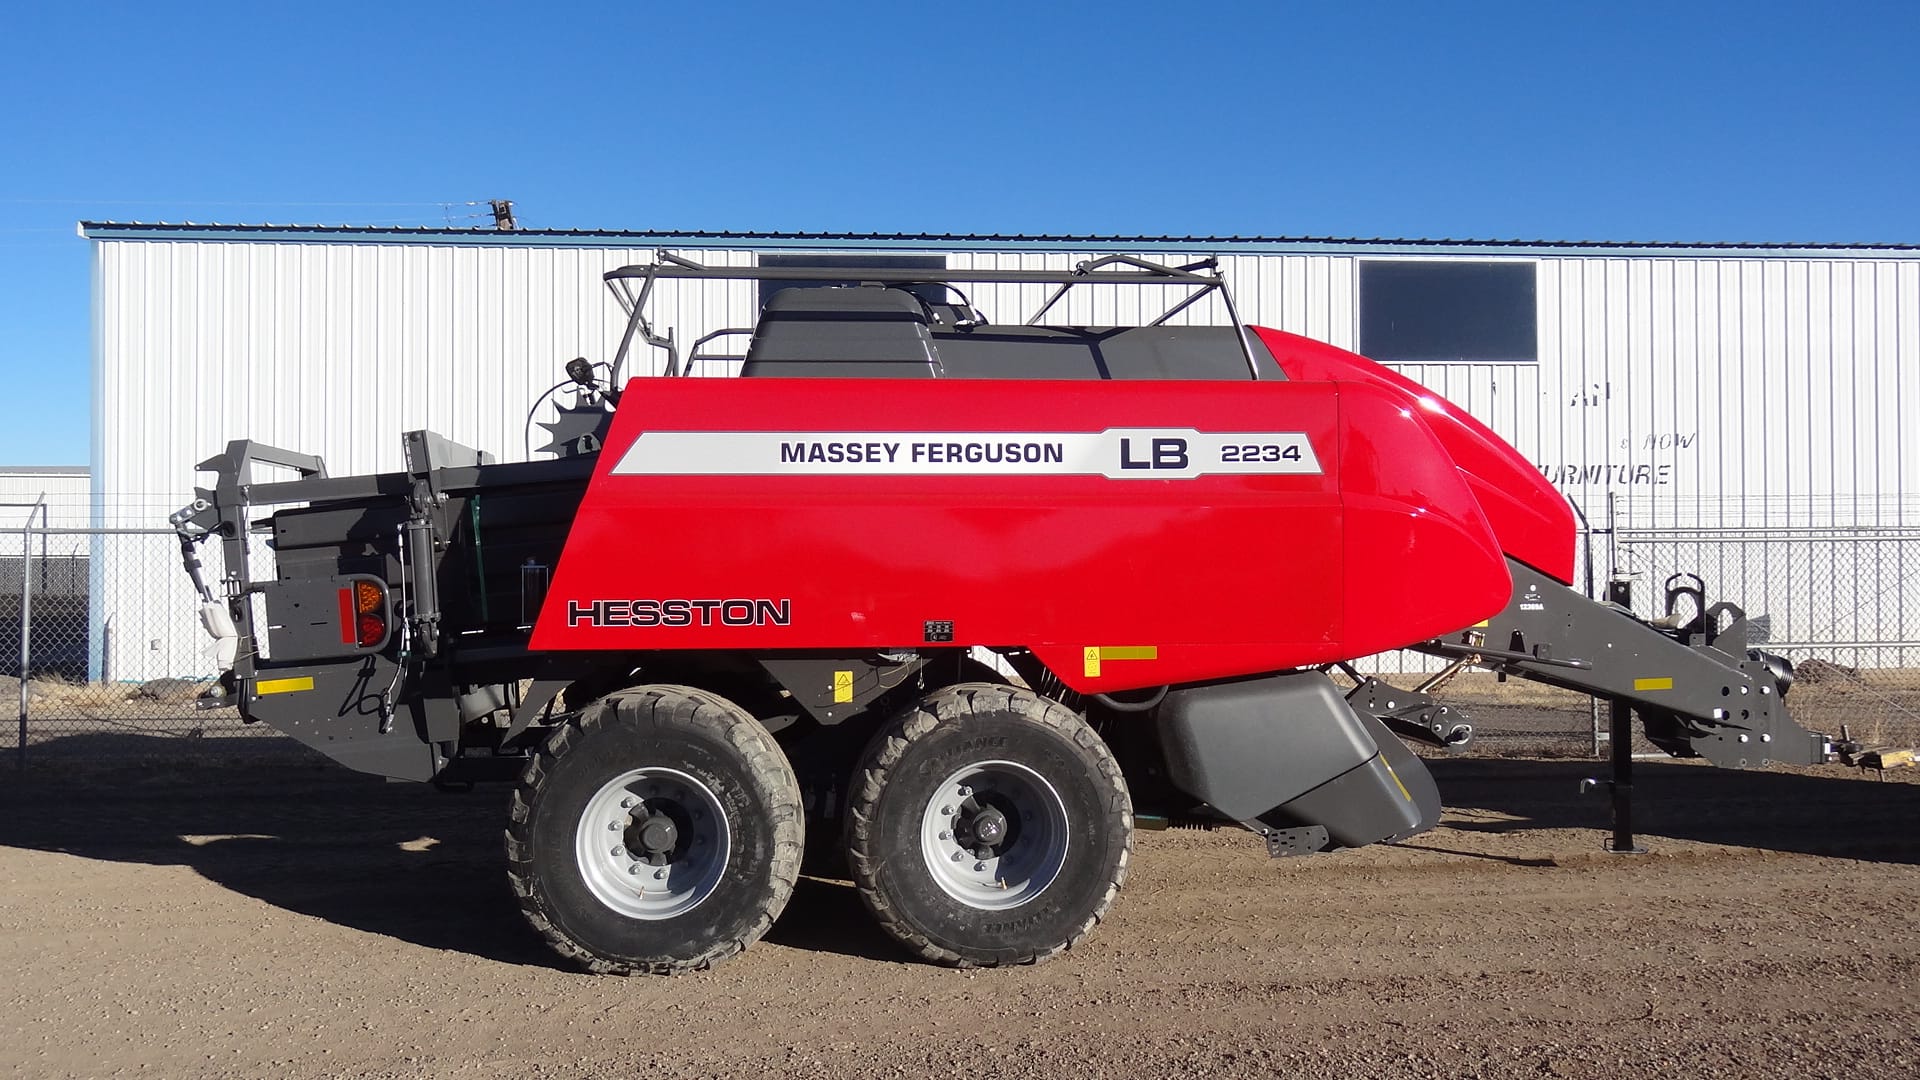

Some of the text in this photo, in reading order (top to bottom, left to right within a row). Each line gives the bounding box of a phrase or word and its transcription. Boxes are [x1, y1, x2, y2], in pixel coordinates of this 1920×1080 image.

[780, 438, 1301, 470] MASSEY FERGUSON LB 2234
[1537, 464, 1671, 484] URNITURE
[567, 599, 791, 627] HESSTON
